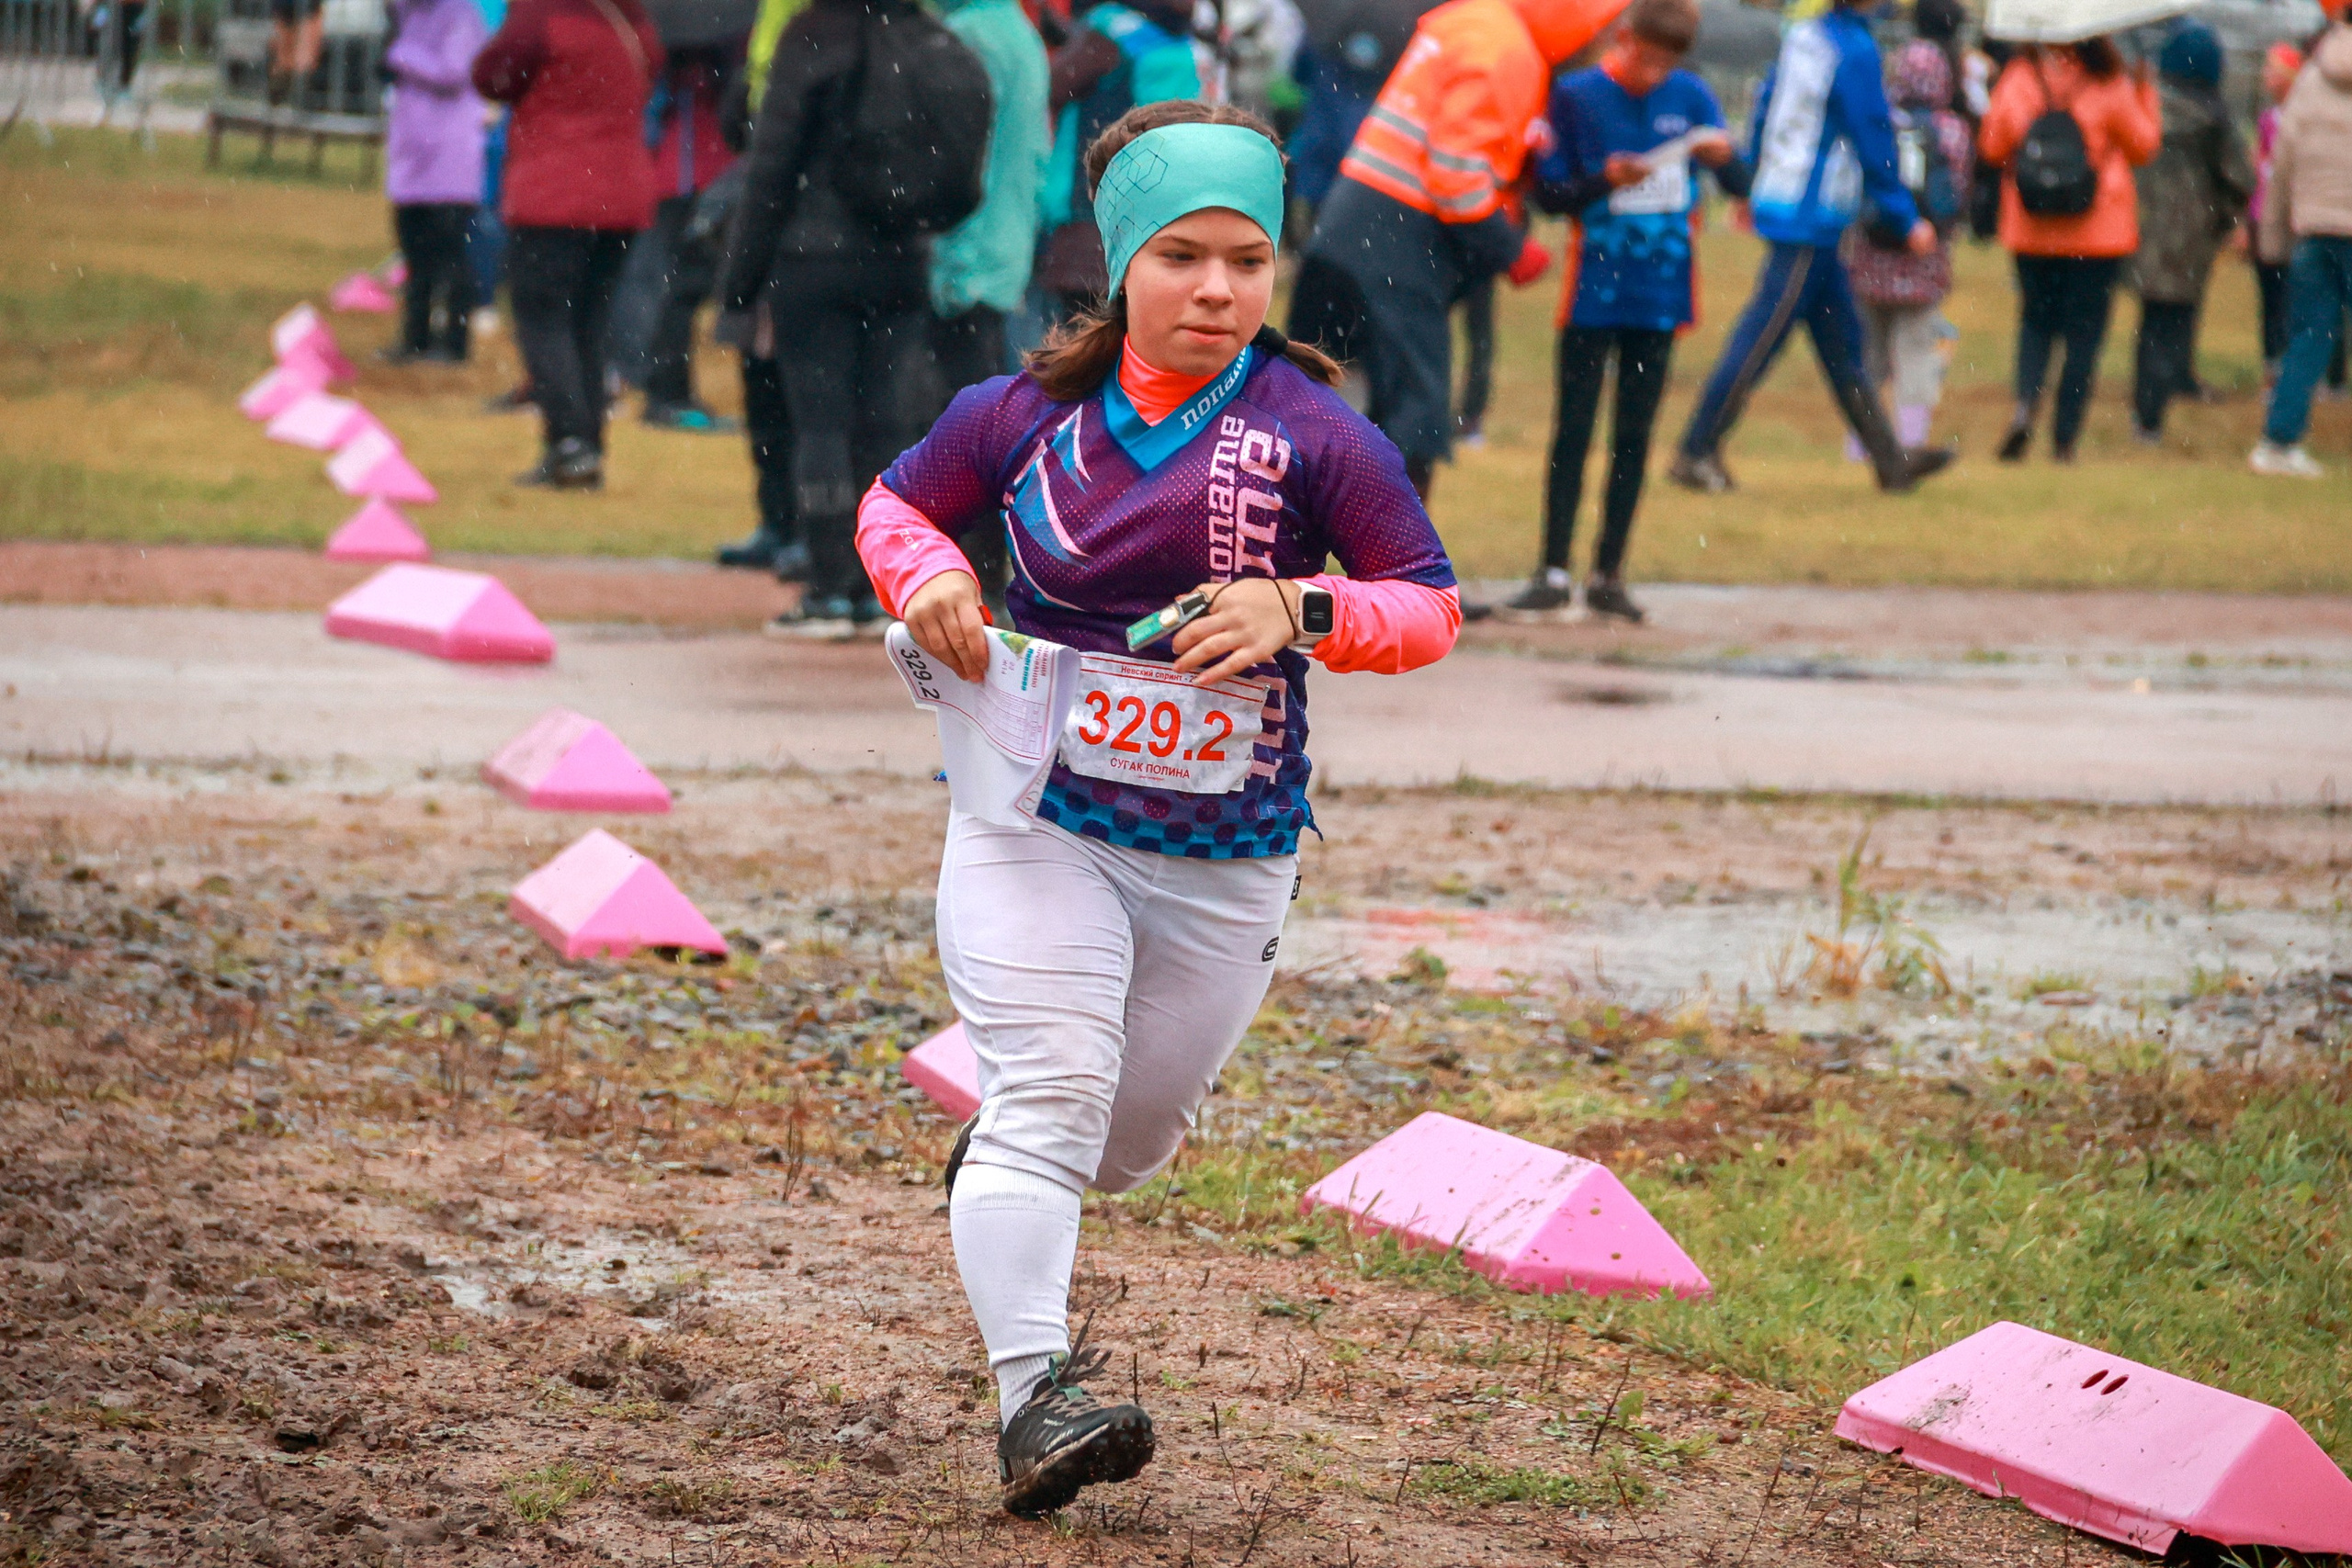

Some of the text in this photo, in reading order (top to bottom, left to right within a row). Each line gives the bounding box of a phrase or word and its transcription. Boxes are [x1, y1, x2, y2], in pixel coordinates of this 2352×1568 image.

[900, 648, 941, 700] 329.2
[1120, 665, 1153, 677] Невский
[1155, 671, 1182, 682] спринт
[1078, 690, 1234, 761] 329.2
[1110, 757, 1143, 773] СУГАК
[1146, 762, 1191, 779] ПОЛИНА
